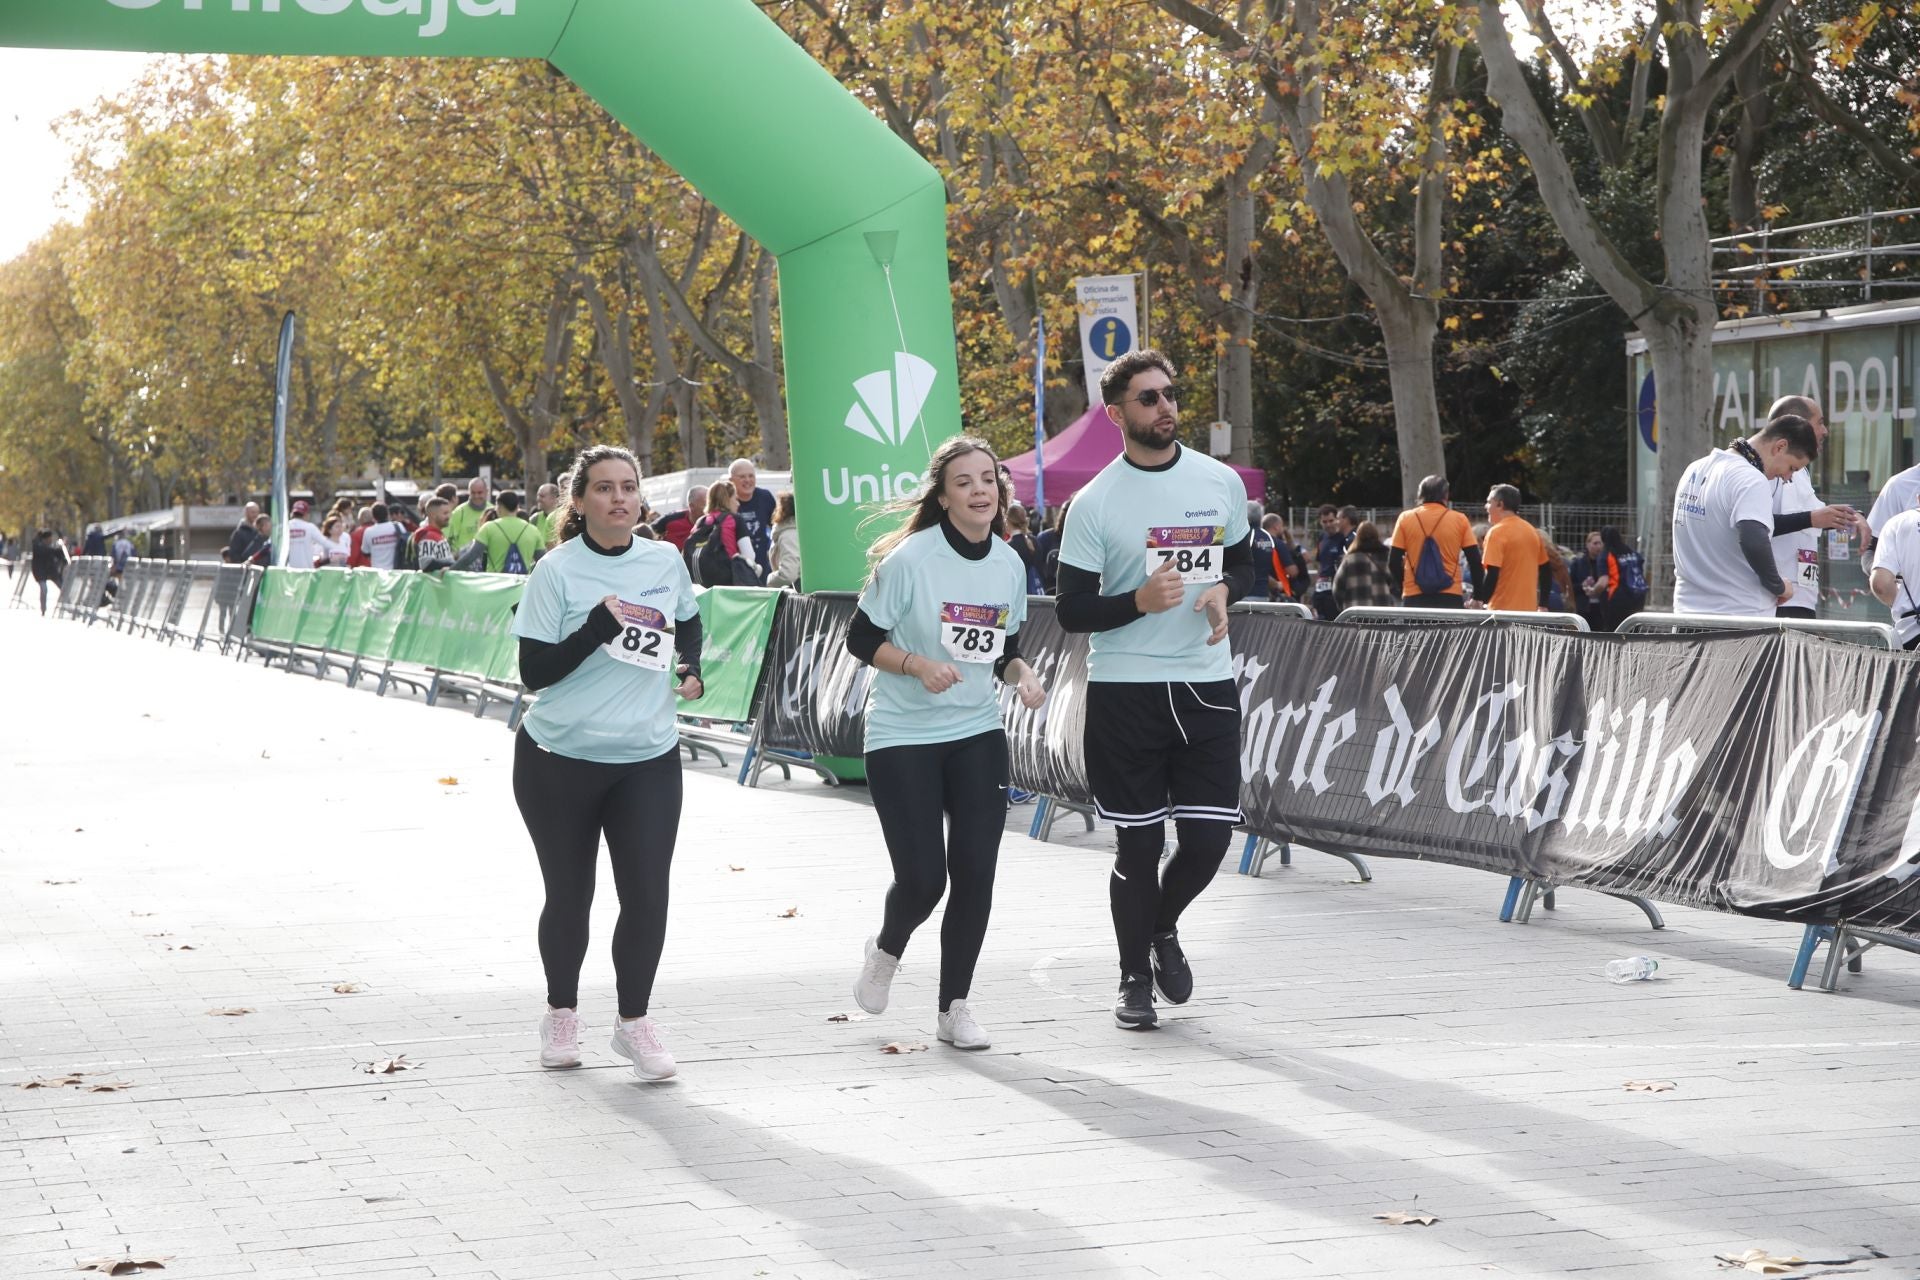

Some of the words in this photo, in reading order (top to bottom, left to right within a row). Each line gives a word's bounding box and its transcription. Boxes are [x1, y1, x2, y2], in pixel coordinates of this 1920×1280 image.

[1083, 286, 1108, 294] Oficina
[822, 463, 932, 505] Unic
[1185, 509, 1218, 518] OneHealth
[1157, 548, 1212, 573] 784
[622, 626, 661, 658] 82
[951, 626, 995, 653] 783
[1361, 683, 1442, 809] de
[1445, 679, 1698, 842] Castilla
